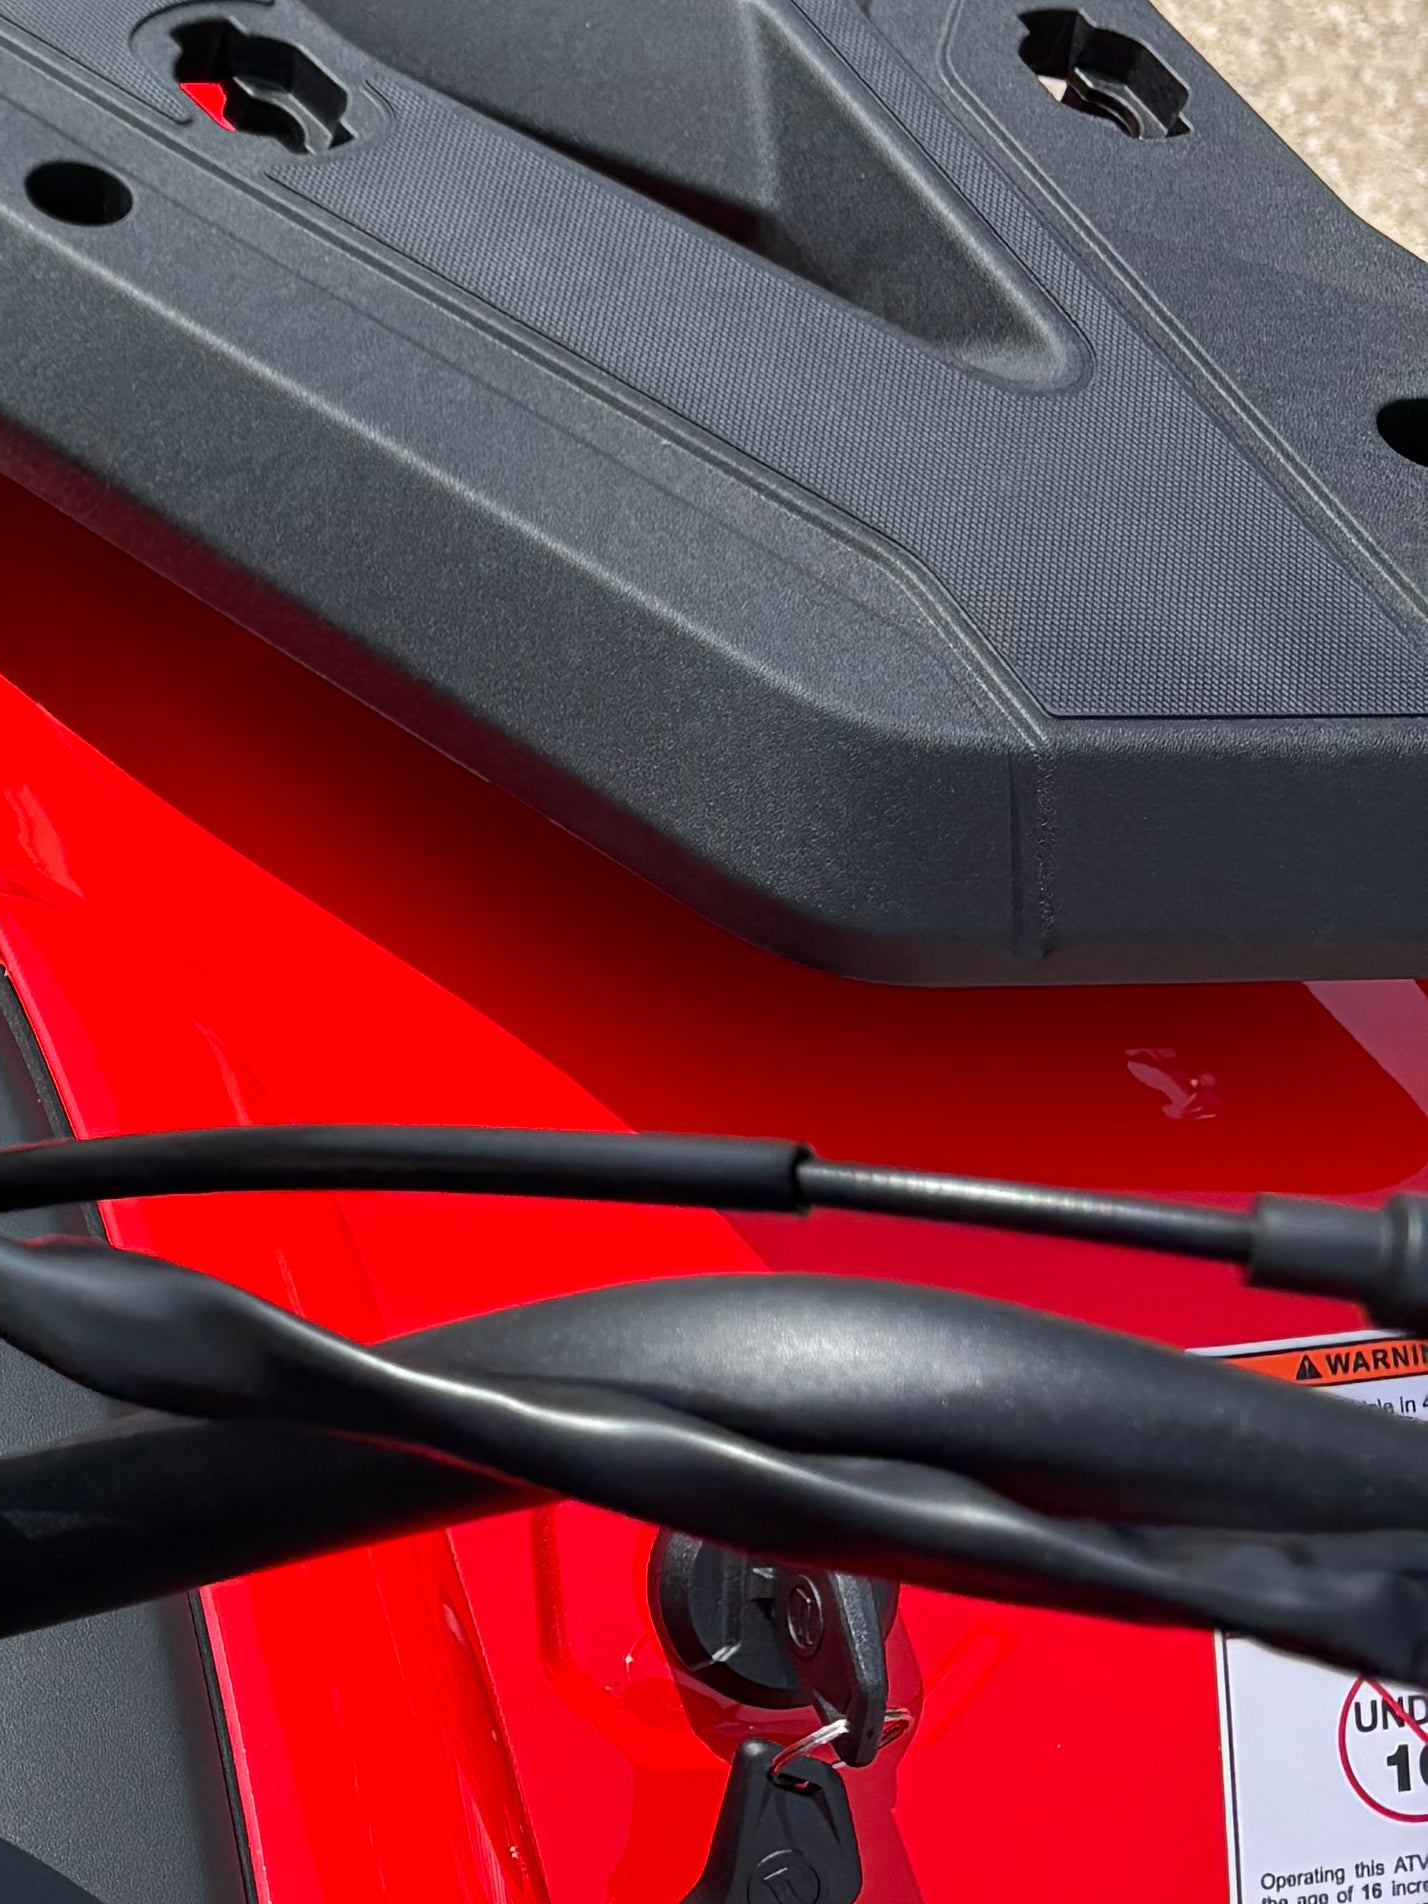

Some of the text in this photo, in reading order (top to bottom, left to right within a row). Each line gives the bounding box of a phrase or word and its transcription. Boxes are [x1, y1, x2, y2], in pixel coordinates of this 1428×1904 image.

[1261, 1866, 1345, 1892] Operating
[1355, 1859, 1384, 1878] this
[1337, 1885, 1353, 1903] of
[1362, 1883, 1382, 1899] 16
